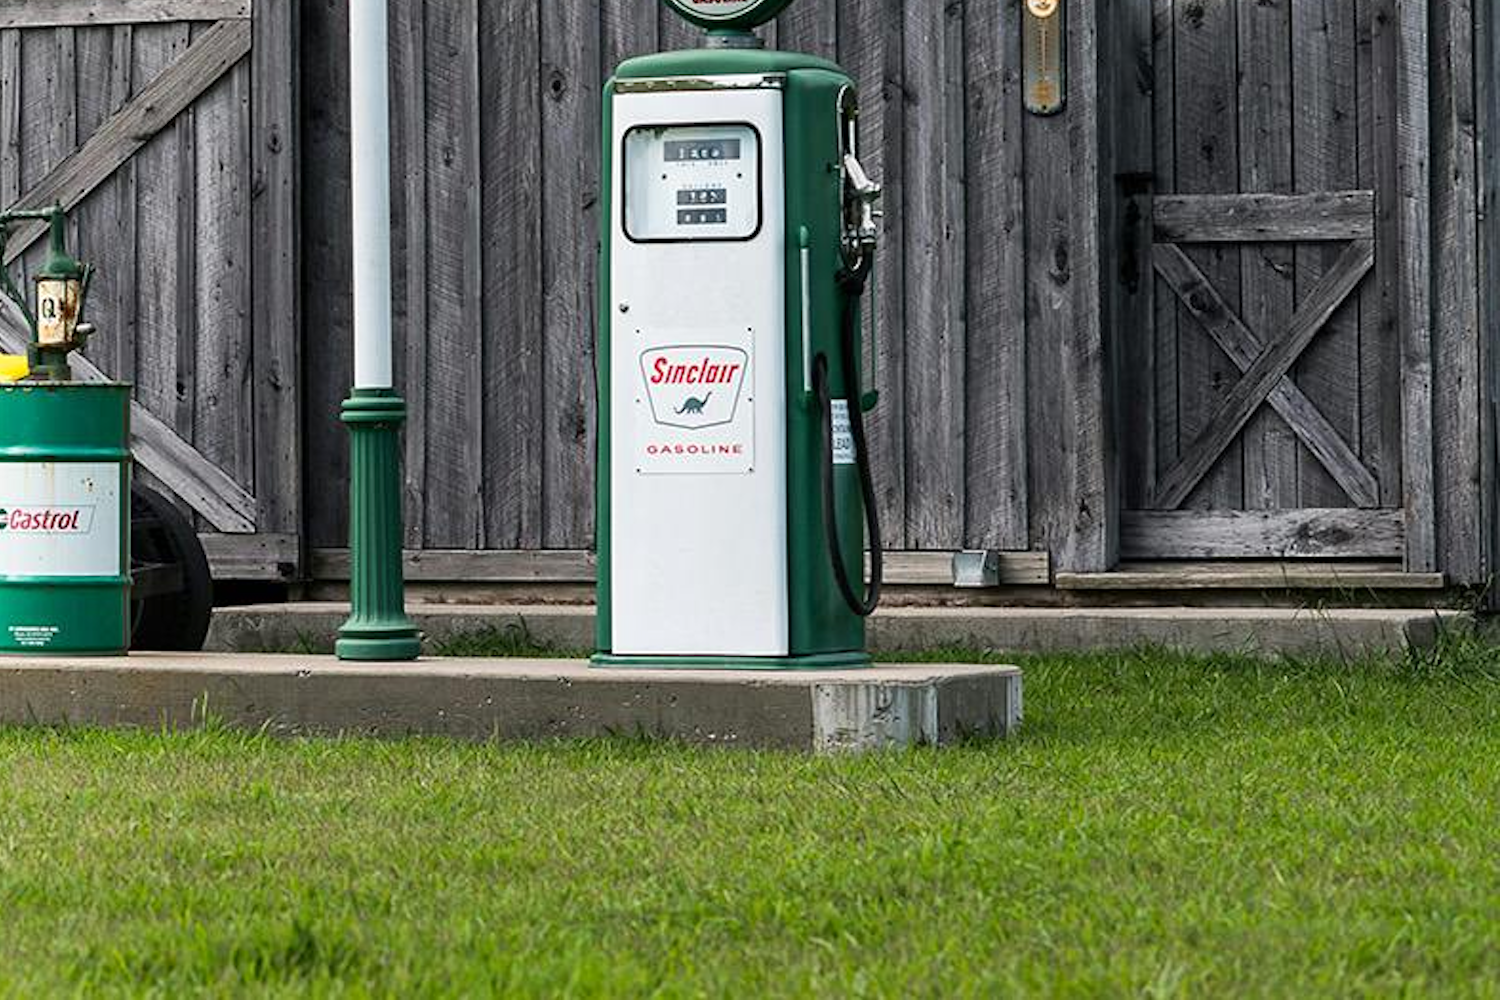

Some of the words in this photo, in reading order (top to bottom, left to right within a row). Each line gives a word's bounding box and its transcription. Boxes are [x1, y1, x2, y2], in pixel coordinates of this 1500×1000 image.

[650, 356, 741, 385] Sinclair
[646, 443, 744, 456] GASOLINE
[9, 506, 79, 532] Castrol
